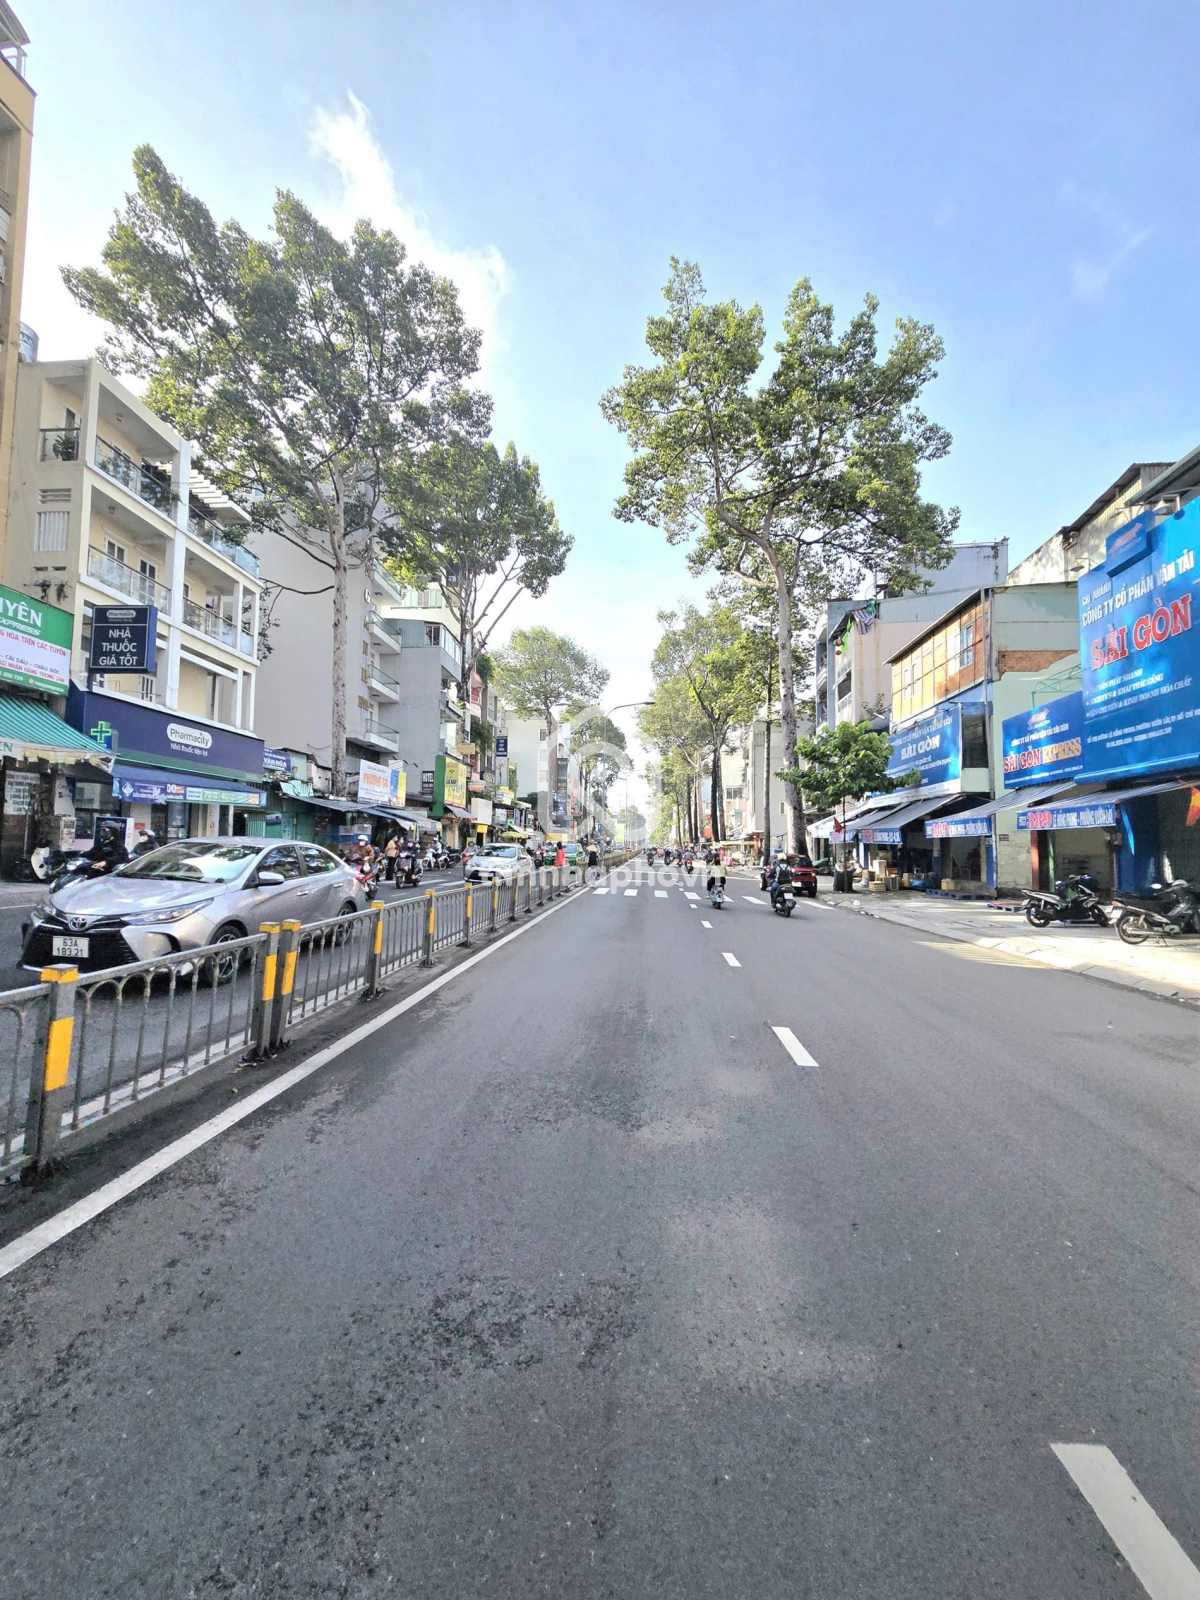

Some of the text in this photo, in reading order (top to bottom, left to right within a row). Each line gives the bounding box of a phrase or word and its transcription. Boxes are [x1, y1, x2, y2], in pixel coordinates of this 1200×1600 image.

[1082, 604, 1103, 627] CÔNG
[1104, 597, 1114, 615] TY
[109, 626, 131, 639] NHÀ
[1091, 593, 1192, 671] SÀI GÒN
[101, 638, 137, 652] THUỐC
[99, 652, 138, 666] GIÁ TỐT
[171, 728, 210, 747] Pharmacity
[901, 735, 940, 760] SÀI GÒN
[1020, 745, 1041, 769] GÒN
[1042, 737, 1082, 764] EXPRESS
[1026, 811, 1052, 829] 389
[62, 938, 78, 947] 63A
